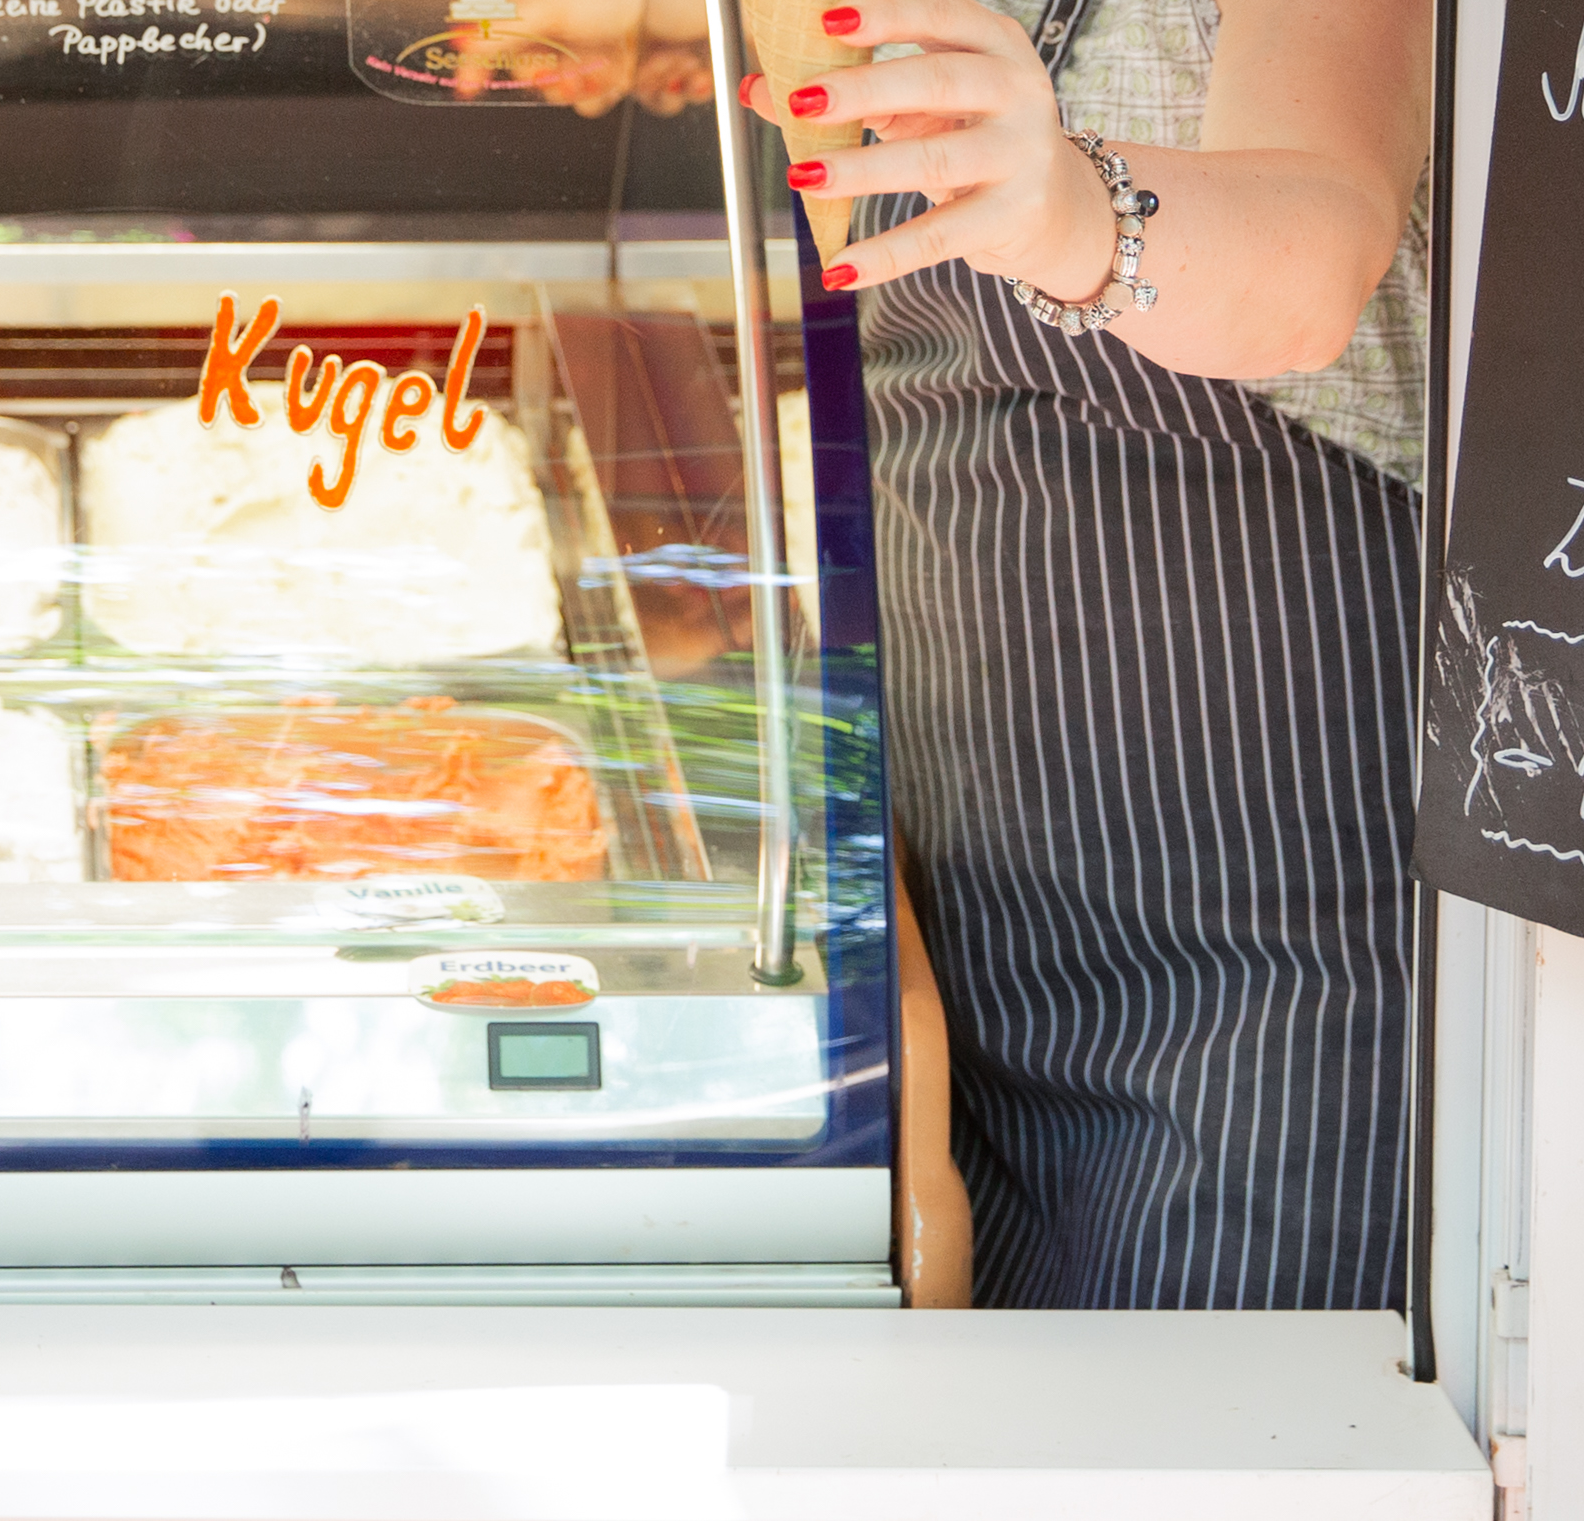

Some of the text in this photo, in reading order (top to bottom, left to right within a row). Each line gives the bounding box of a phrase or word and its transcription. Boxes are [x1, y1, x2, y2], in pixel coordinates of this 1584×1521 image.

[198, 289, 488, 512] Kugel
[348, 880, 463, 901] Vanille
[439, 958, 572, 976] Erdbeer
